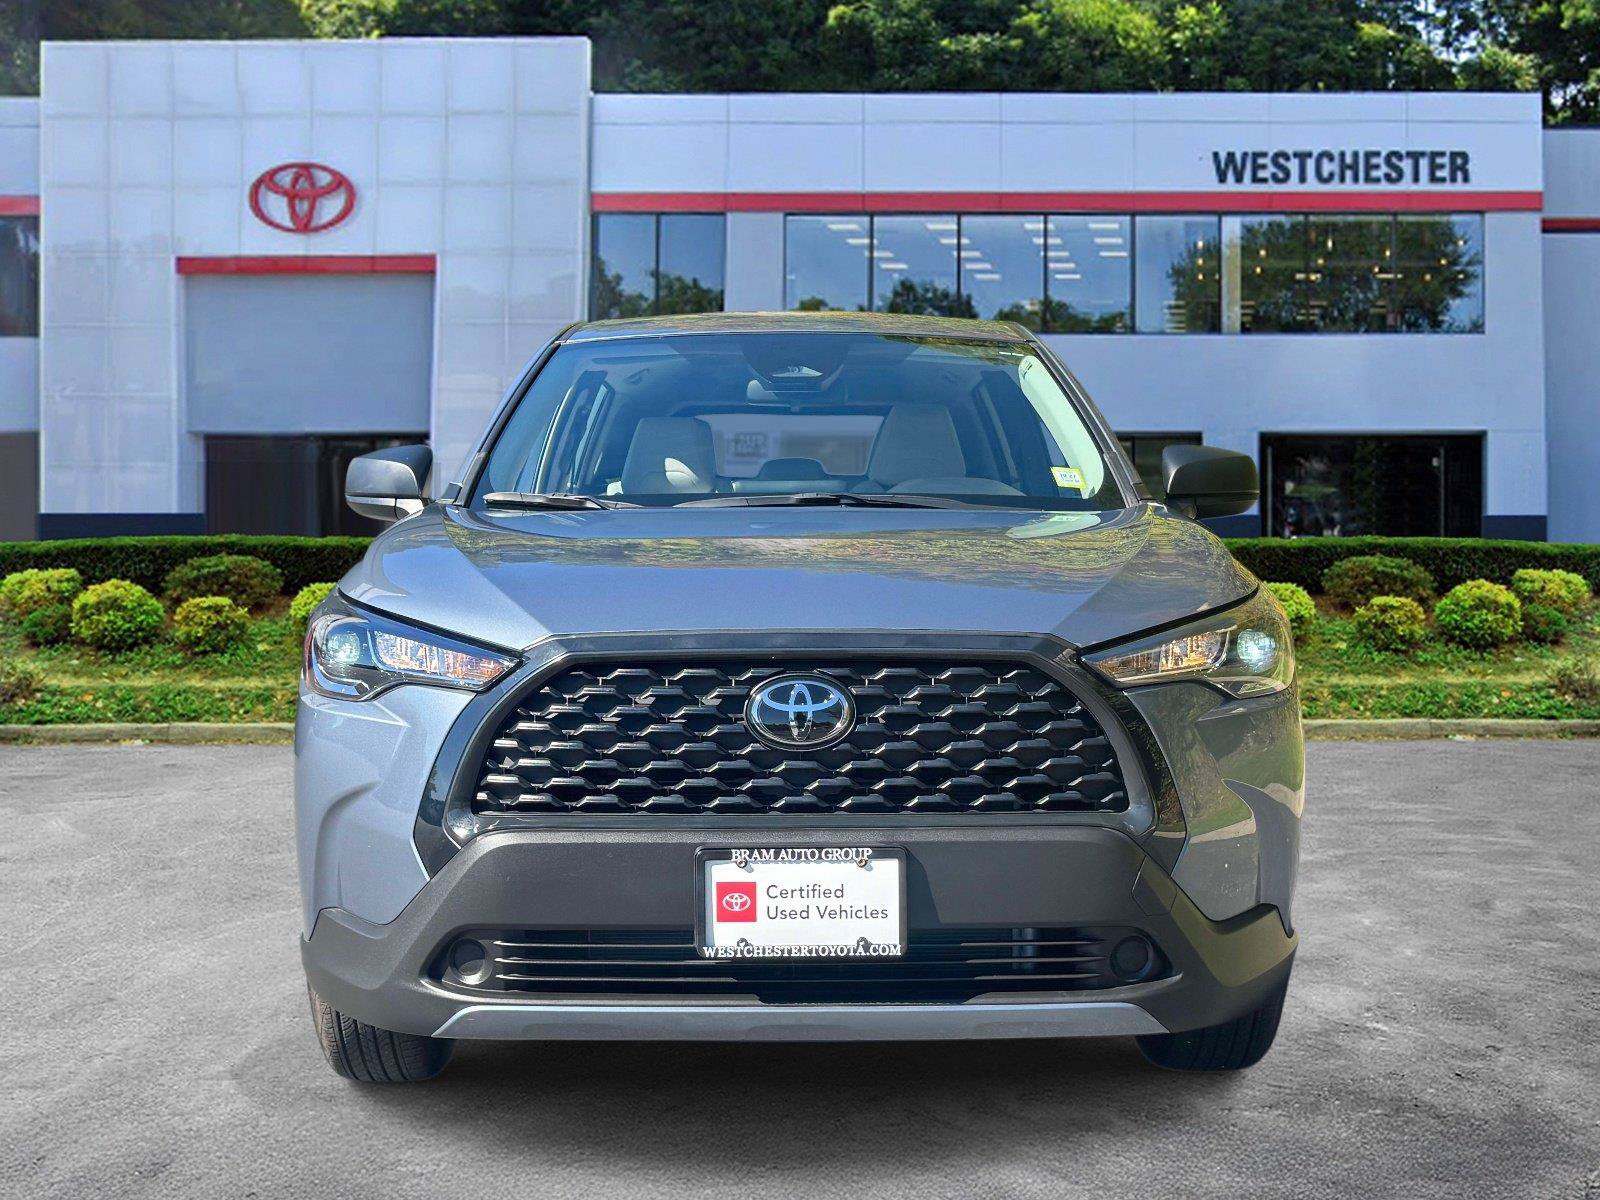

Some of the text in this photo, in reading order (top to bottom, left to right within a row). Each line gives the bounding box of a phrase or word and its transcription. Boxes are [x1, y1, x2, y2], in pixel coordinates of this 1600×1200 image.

[1212, 150, 1471, 184] WESTCHESTER
[731, 848, 873, 862] BRAM AUTO GROUP
[765, 884, 845, 899] Certified
[765, 904, 889, 920] Used Vehicles
[702, 944, 902, 958] WESTCHESTERTOYOTA.COM
